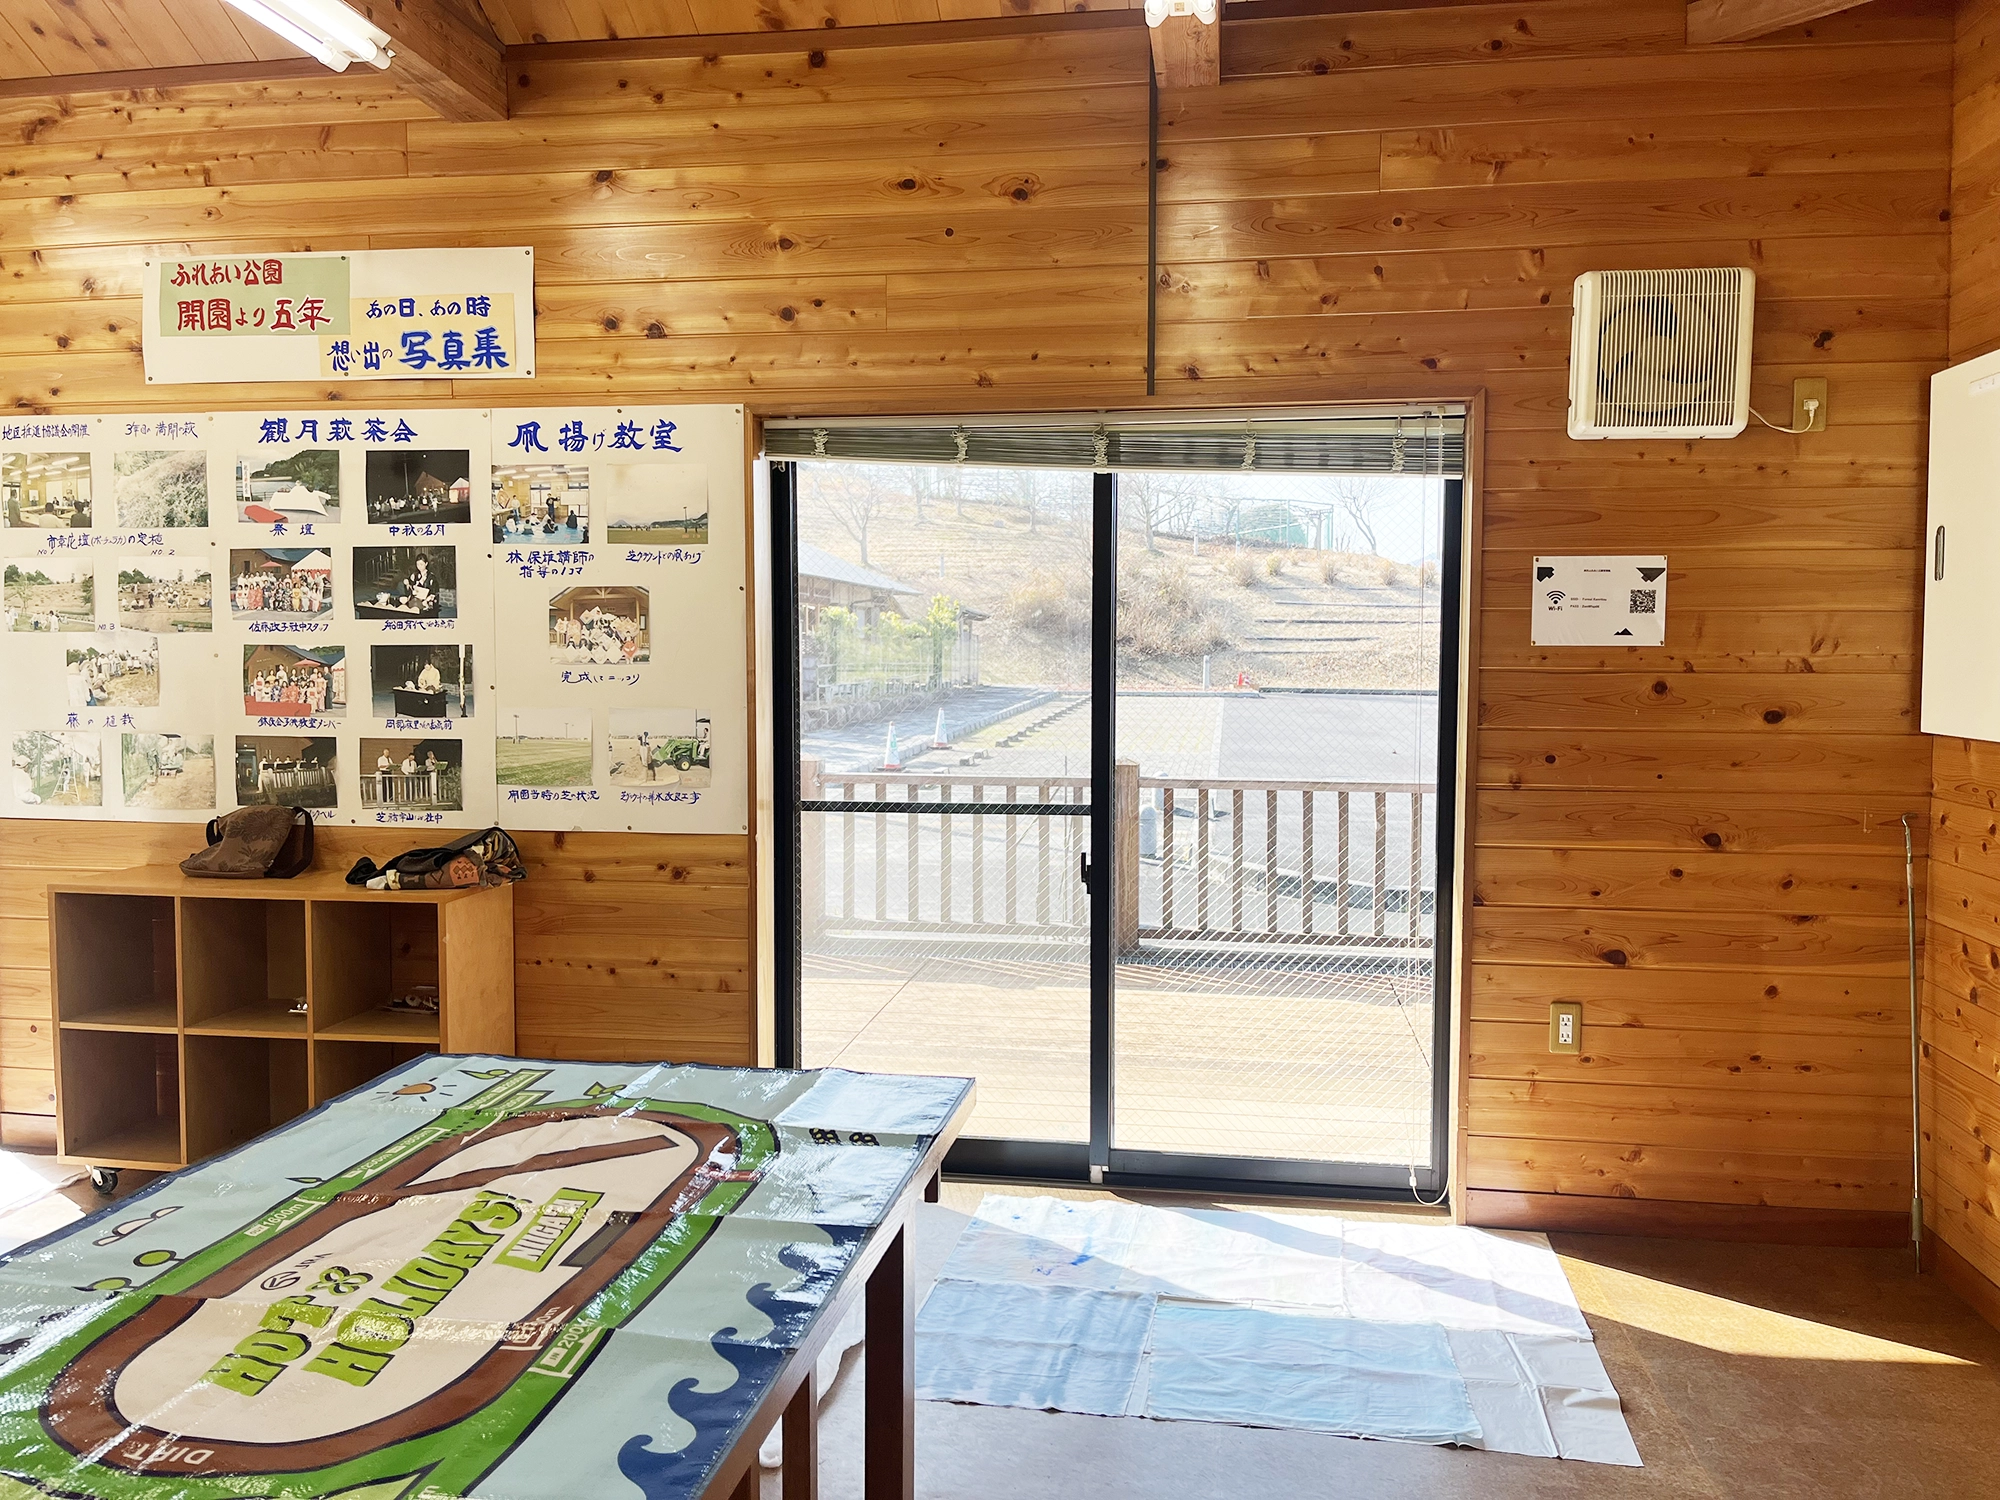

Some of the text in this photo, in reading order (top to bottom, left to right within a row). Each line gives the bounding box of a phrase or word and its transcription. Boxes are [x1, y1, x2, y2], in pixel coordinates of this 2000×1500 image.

[170, 259, 283, 287] ふれあい公園
[177, 295, 332, 332] 開園より五年
[258, 417, 419, 444] 観月萩茶会
[507, 418, 684, 453] 凧揚げ教室
[388, 523, 445, 537] 中秋の名月
[109, 622, 116, 630] 3
[66, 712, 137, 730] 藤の植栽
[201, 1294, 341, 1397] HOT
[123, 1443, 215, 1466] DIRT
